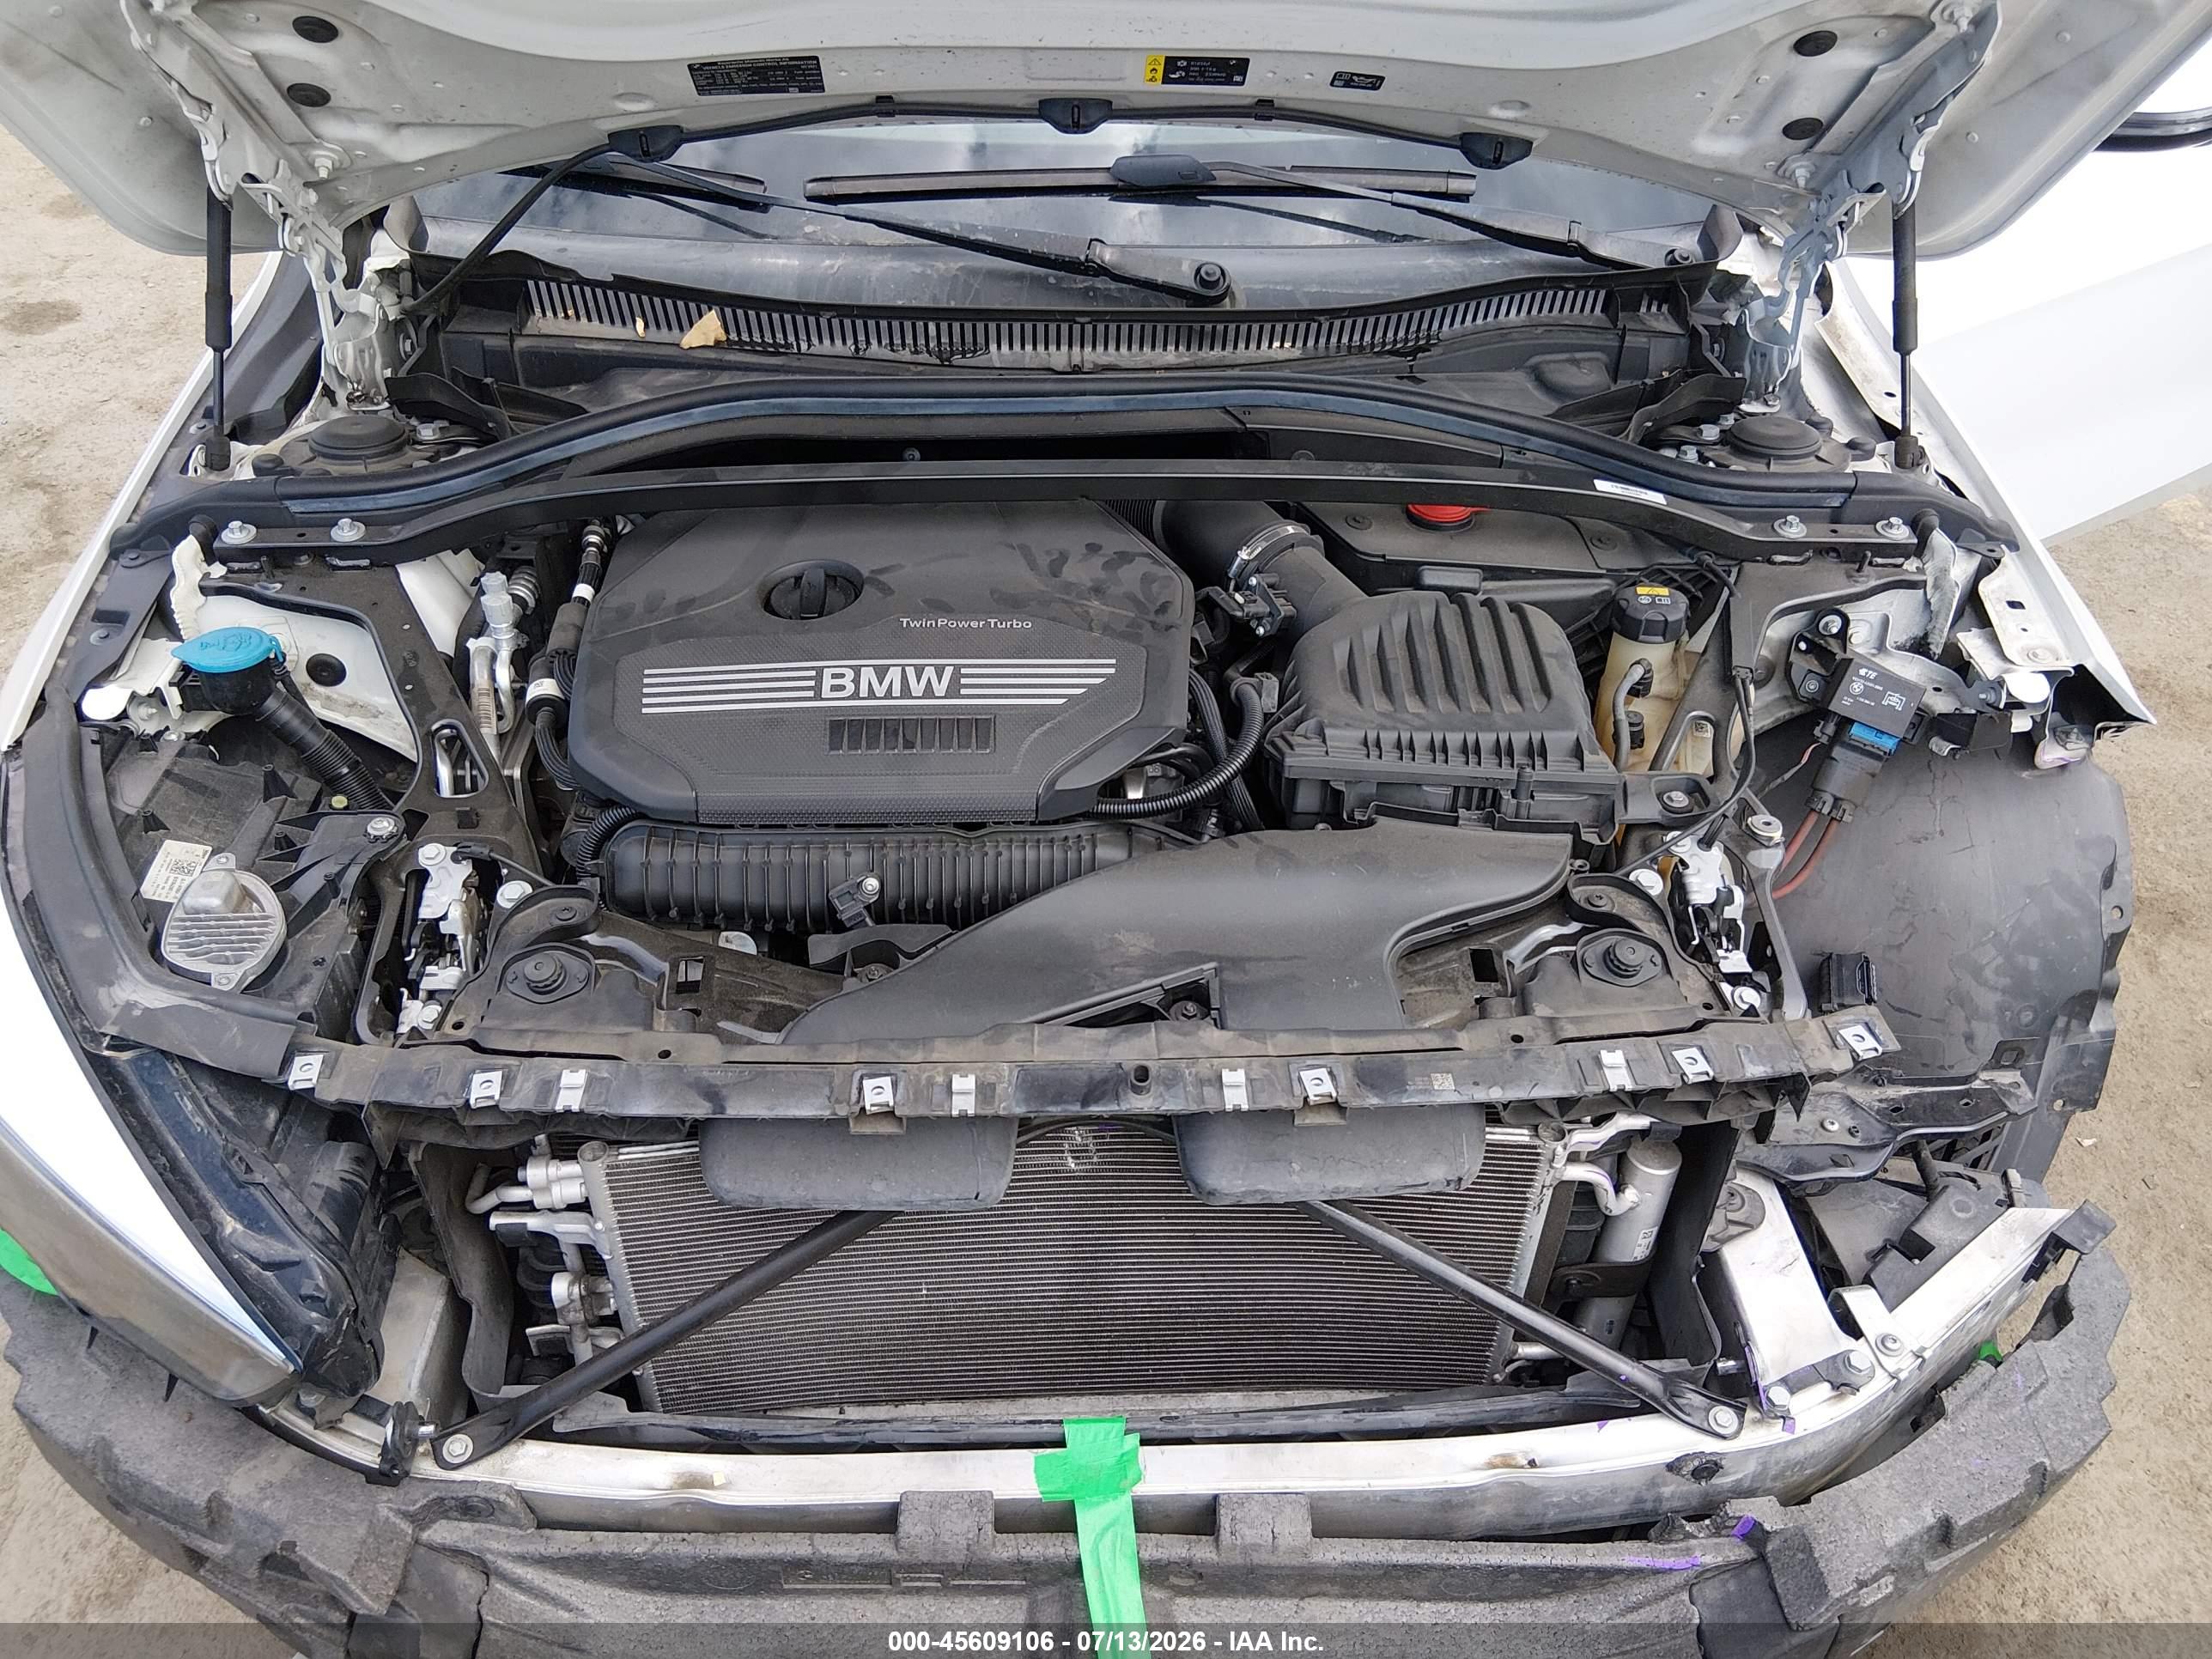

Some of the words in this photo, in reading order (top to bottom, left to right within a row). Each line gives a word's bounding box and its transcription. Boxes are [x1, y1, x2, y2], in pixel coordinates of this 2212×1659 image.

[900, 617, 986, 629] TwinPower
[988, 618, 1032, 629] Turbo
[821, 665, 955, 699] BMW
